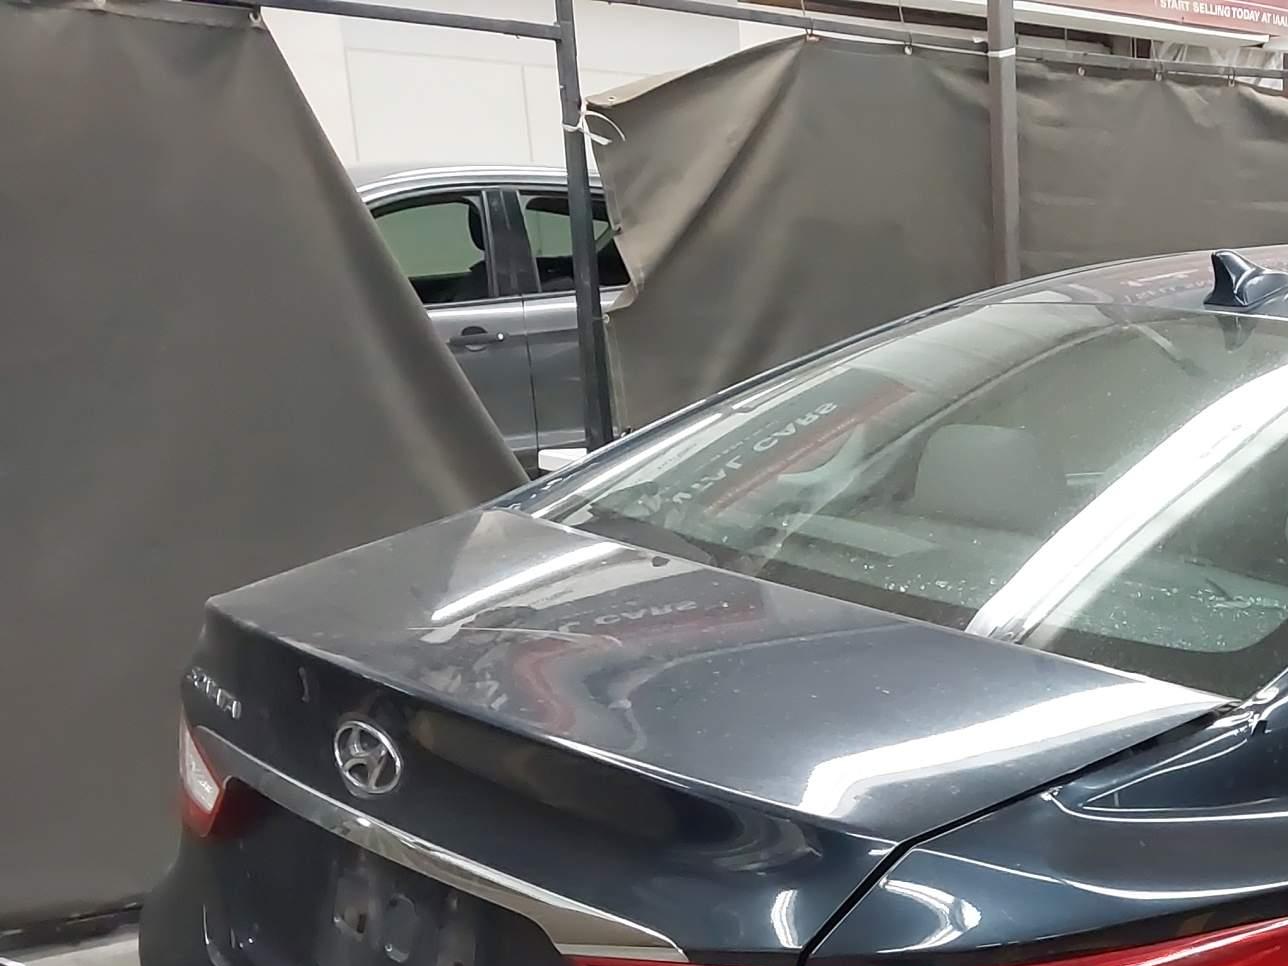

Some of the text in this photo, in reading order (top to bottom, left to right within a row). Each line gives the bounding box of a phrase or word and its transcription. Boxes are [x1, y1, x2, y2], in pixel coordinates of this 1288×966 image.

[1160, 0, 1190, 12] START
[1192, 2, 1231, 18] SELLING
[1231, 8, 1260, 22] TODAY
[1261, 12, 1272, 24] AT
